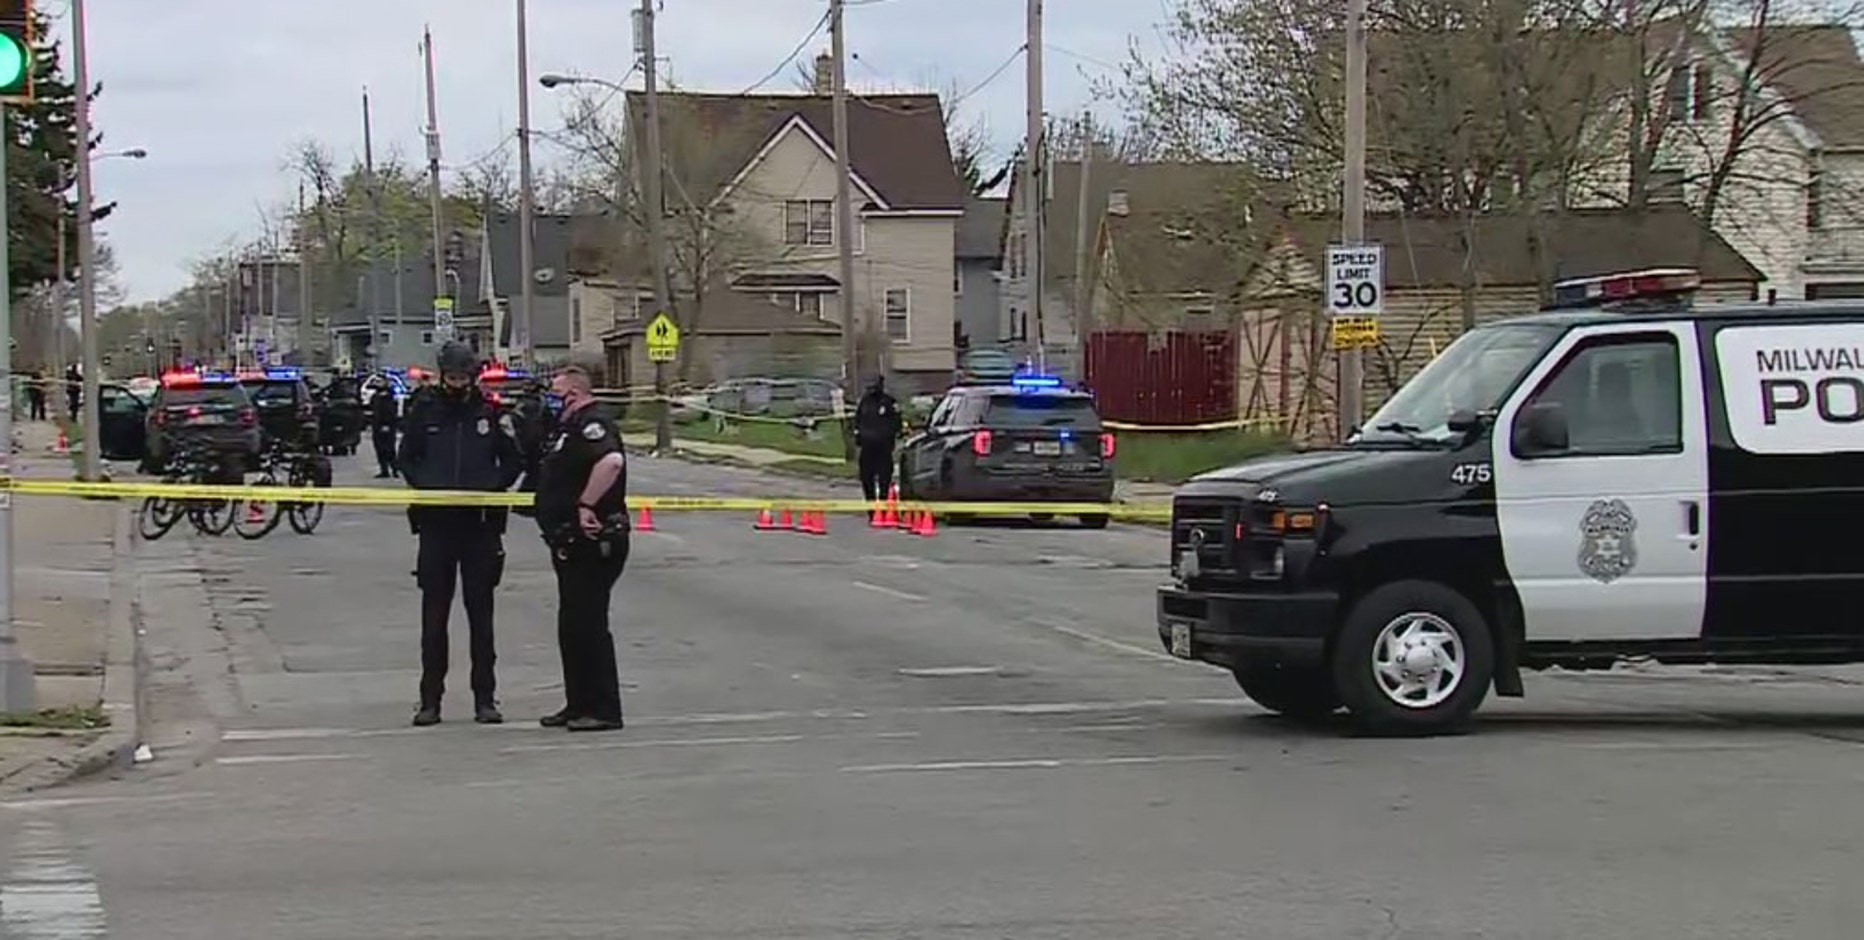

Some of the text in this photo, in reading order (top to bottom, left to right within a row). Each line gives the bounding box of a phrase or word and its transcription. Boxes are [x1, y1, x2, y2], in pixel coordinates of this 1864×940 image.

[1332, 253, 1377, 266] SPEED
[1336, 268, 1371, 280] LIMIT
[1333, 281, 1377, 308] 30
[1760, 376, 1864, 425] PO
[1451, 463, 1491, 483] 475
